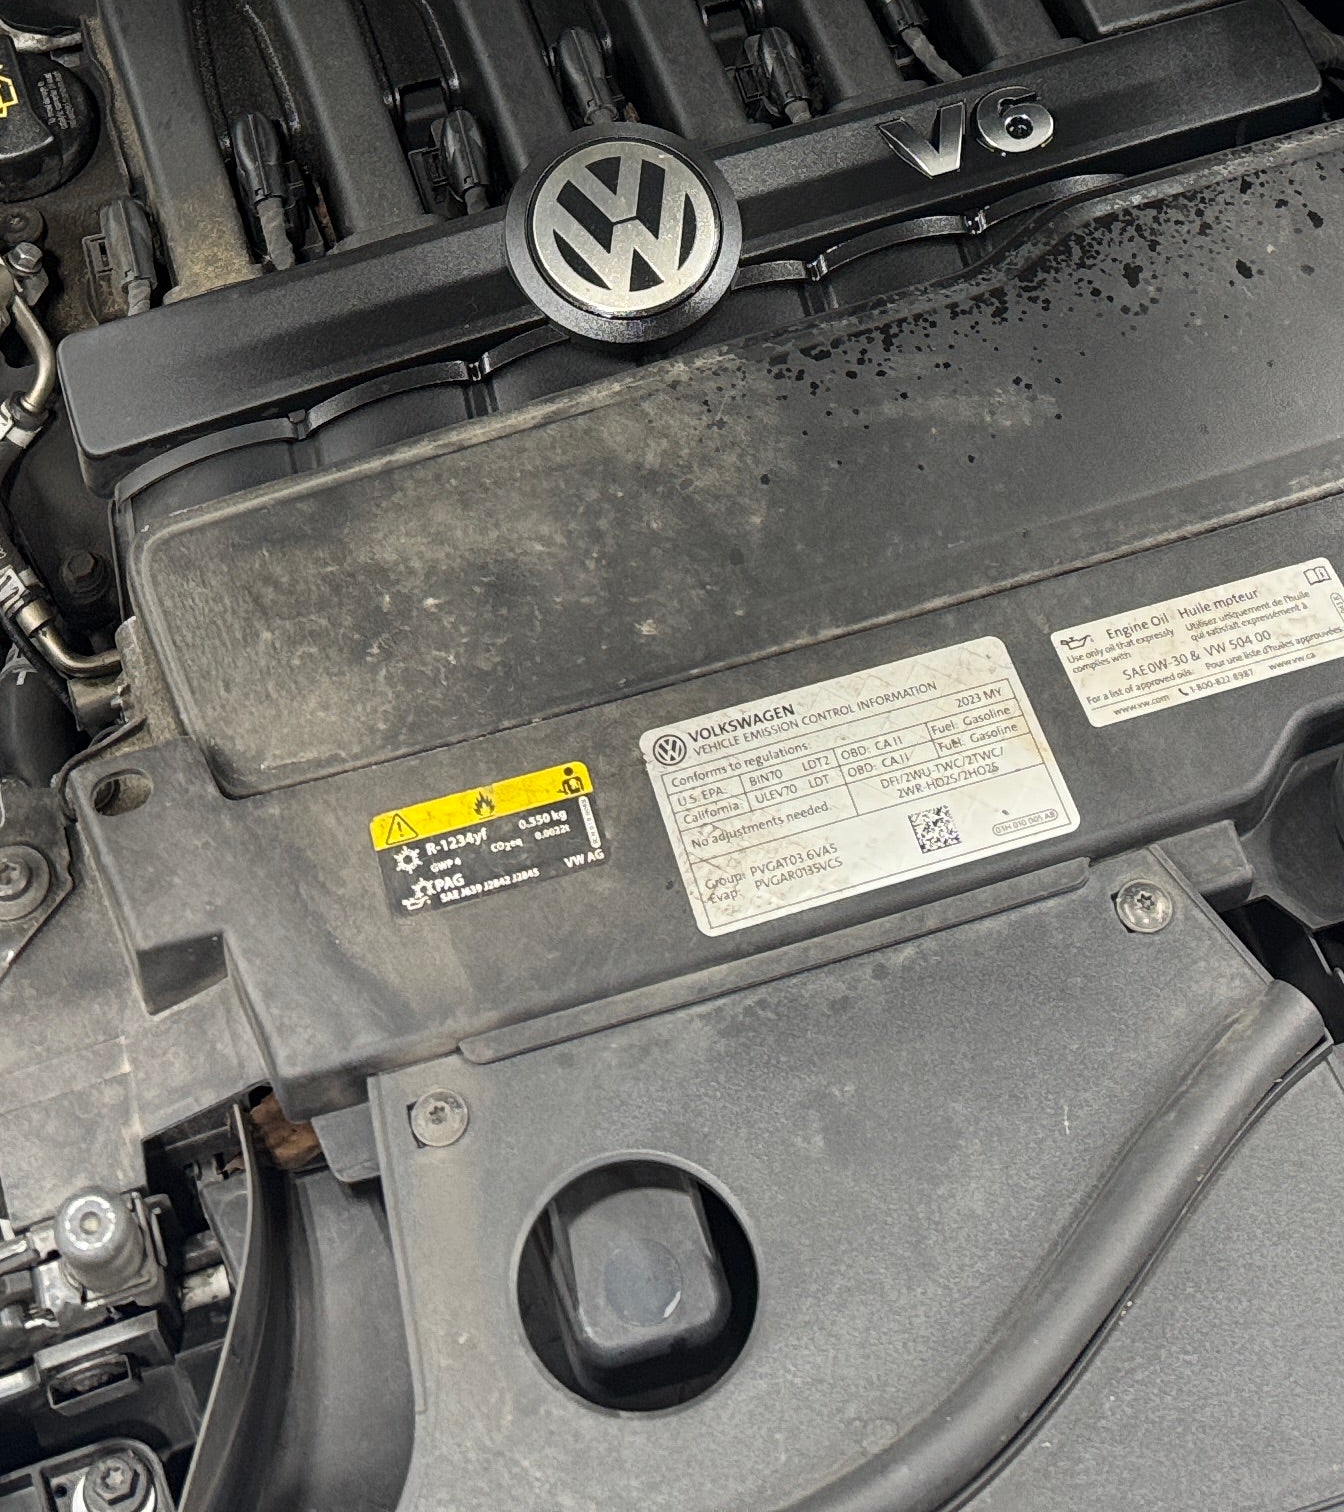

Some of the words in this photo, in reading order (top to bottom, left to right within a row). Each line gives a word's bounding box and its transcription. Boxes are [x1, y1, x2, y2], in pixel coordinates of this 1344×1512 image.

[877, 85, 1055, 178] V6
[1106, 619, 1149, 641] Engine
[1150, 613, 1169, 626] Oil
[1177, 600, 1211, 619] Huile
[1213, 588, 1259, 609] moteur
[1272, 598, 1282, 607] de
[1067, 653, 1083, 663] Use
[1085, 647, 1103, 659] only
[1117, 639, 1134, 649] that
[1135, 627, 1174, 645] expressly
[1111, 651, 1131, 662] with
[1189, 649, 1199, 661] &
[1204, 642, 1226, 657] VW
[1229, 634, 1252, 649] 504
[1254, 629, 1271, 642] 00
[1226, 654, 1241, 663] une
[1086, 694, 1101, 703] For
[1109, 687, 1123, 697] list
[1123, 684, 1133, 693] of
[1135, 673, 1175, 692] approved
[688, 703, 794, 743] VOLKSWAGEN
[693, 735, 740, 756] VEHICLE
[743, 719, 799, 742] EMISSION
[801, 703, 854, 726] CONTROL
[857, 680, 937, 710] INFORMATION
[670, 764, 726, 787] Conforms
[728, 760, 741, 771] to
[955, 693, 980, 707] 2023
[983, 687, 1002, 699] MY
[748, 768, 783, 786] BIN70
[801, 754, 830, 771] LDT2
[874, 738, 890, 750] CA
[962, 704, 1011, 726] Gasoline
[755, 783, 797, 803] ULEV70
[808, 774, 829, 788] LDT
[881, 755, 897, 767] CA
[969, 721, 1018, 743] Gasoline
[425, 827, 489, 857] R-1234yf
[552, 810, 567, 822] kg
[691, 836, 708, 849] No
[710, 813, 785, 846] adjustments
[430, 859, 453, 872] GWP
[434, 873, 464, 891] PAG
[564, 853, 586, 868] VW
[588, 849, 604, 861] AG
[704, 870, 746, 890] Group:
[440, 890, 459, 902] SAE
